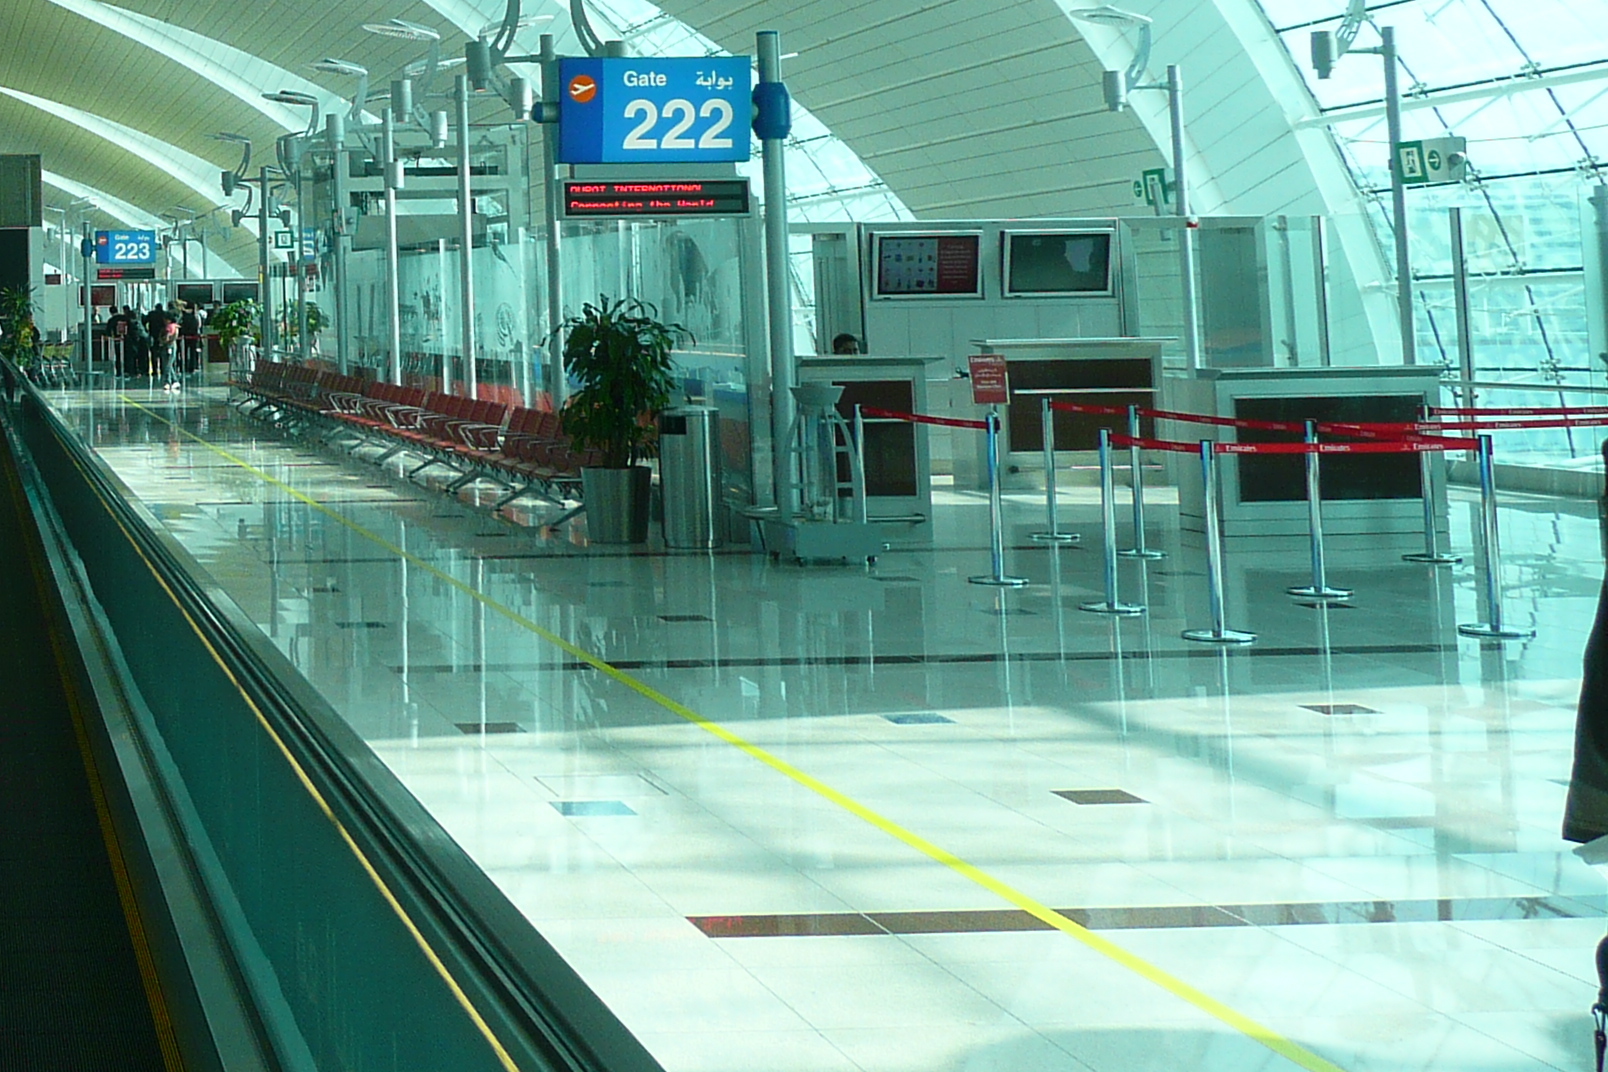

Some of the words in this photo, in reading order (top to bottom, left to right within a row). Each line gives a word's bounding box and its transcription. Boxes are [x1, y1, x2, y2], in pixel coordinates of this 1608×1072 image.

[623, 70, 667, 87] Gate
[695, 70, 734, 90] بوابة
[622, 98, 734, 149] 222
[114, 242, 151, 260] 223
[1225, 445, 1257, 453] Emirates
[1319, 444, 1351, 452] Emirates
[1413, 443, 1444, 451] Emirates
